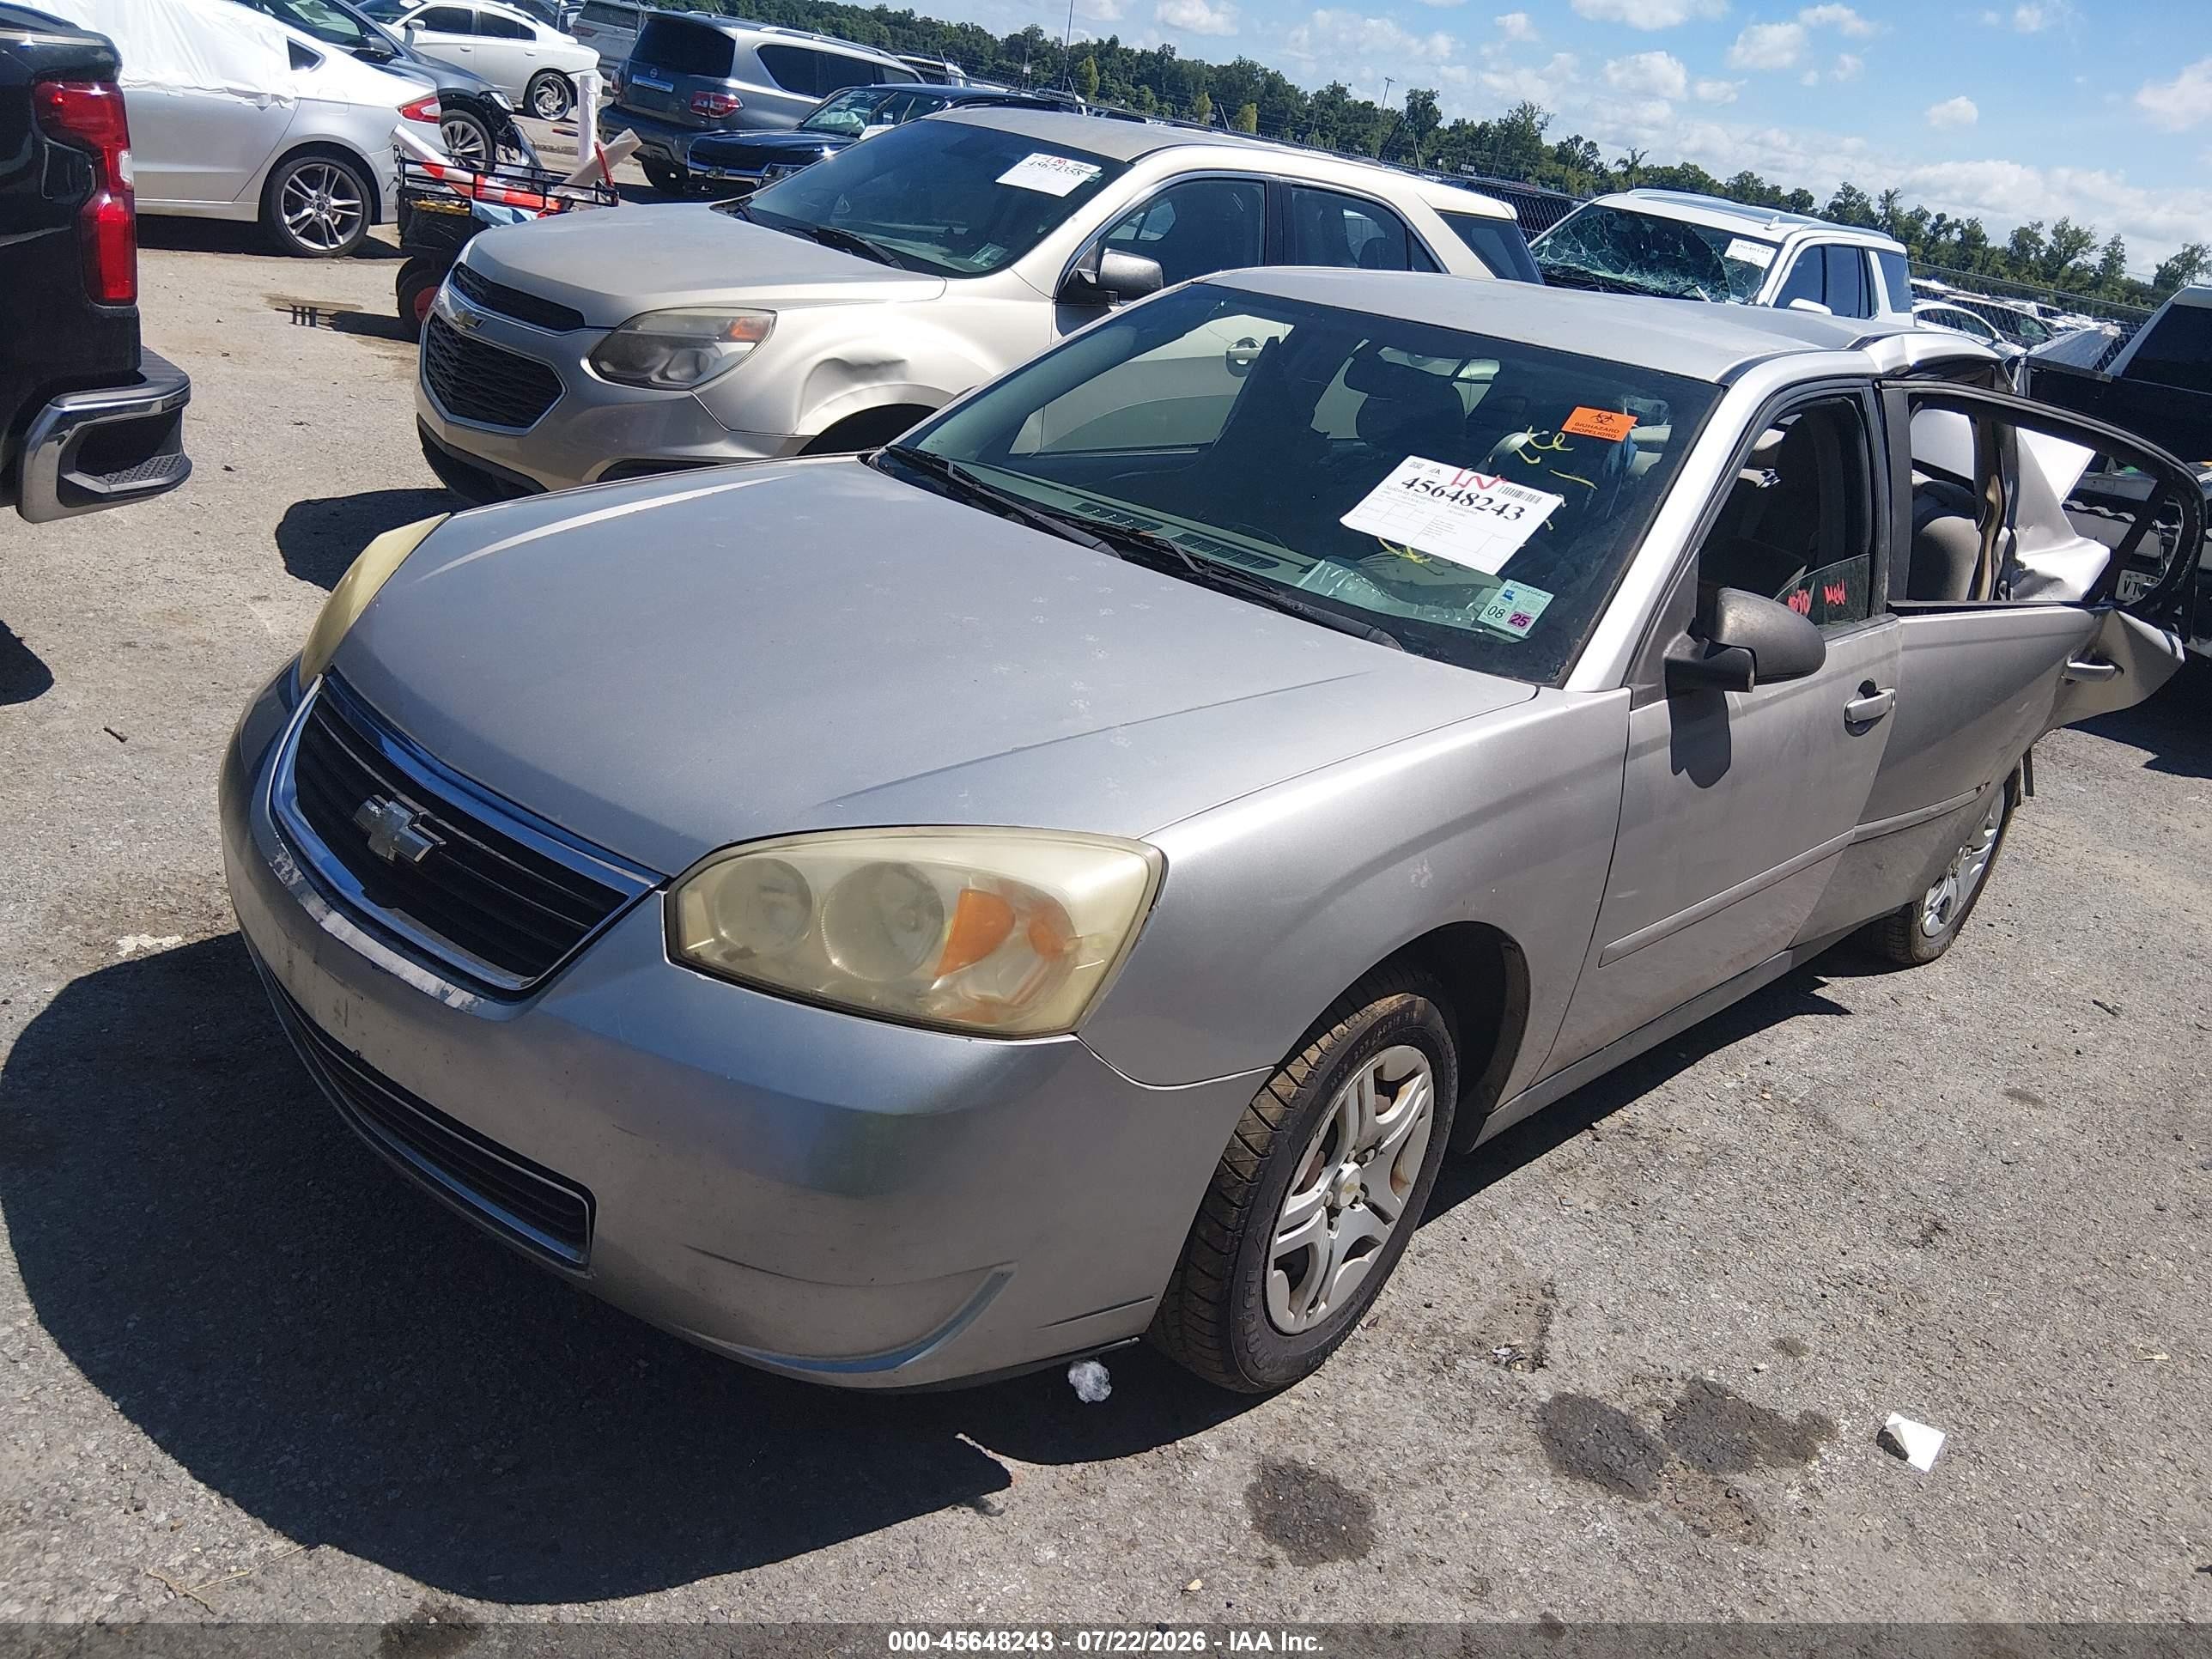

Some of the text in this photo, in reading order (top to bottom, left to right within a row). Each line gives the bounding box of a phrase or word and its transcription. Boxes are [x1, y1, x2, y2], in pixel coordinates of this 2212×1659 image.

[1574, 422, 1620, 434] BIOHAZARD
[1401, 477, 1526, 521] 45648243
[1487, 605, 1506, 619] 08
[1510, 613, 1530, 628] 25
